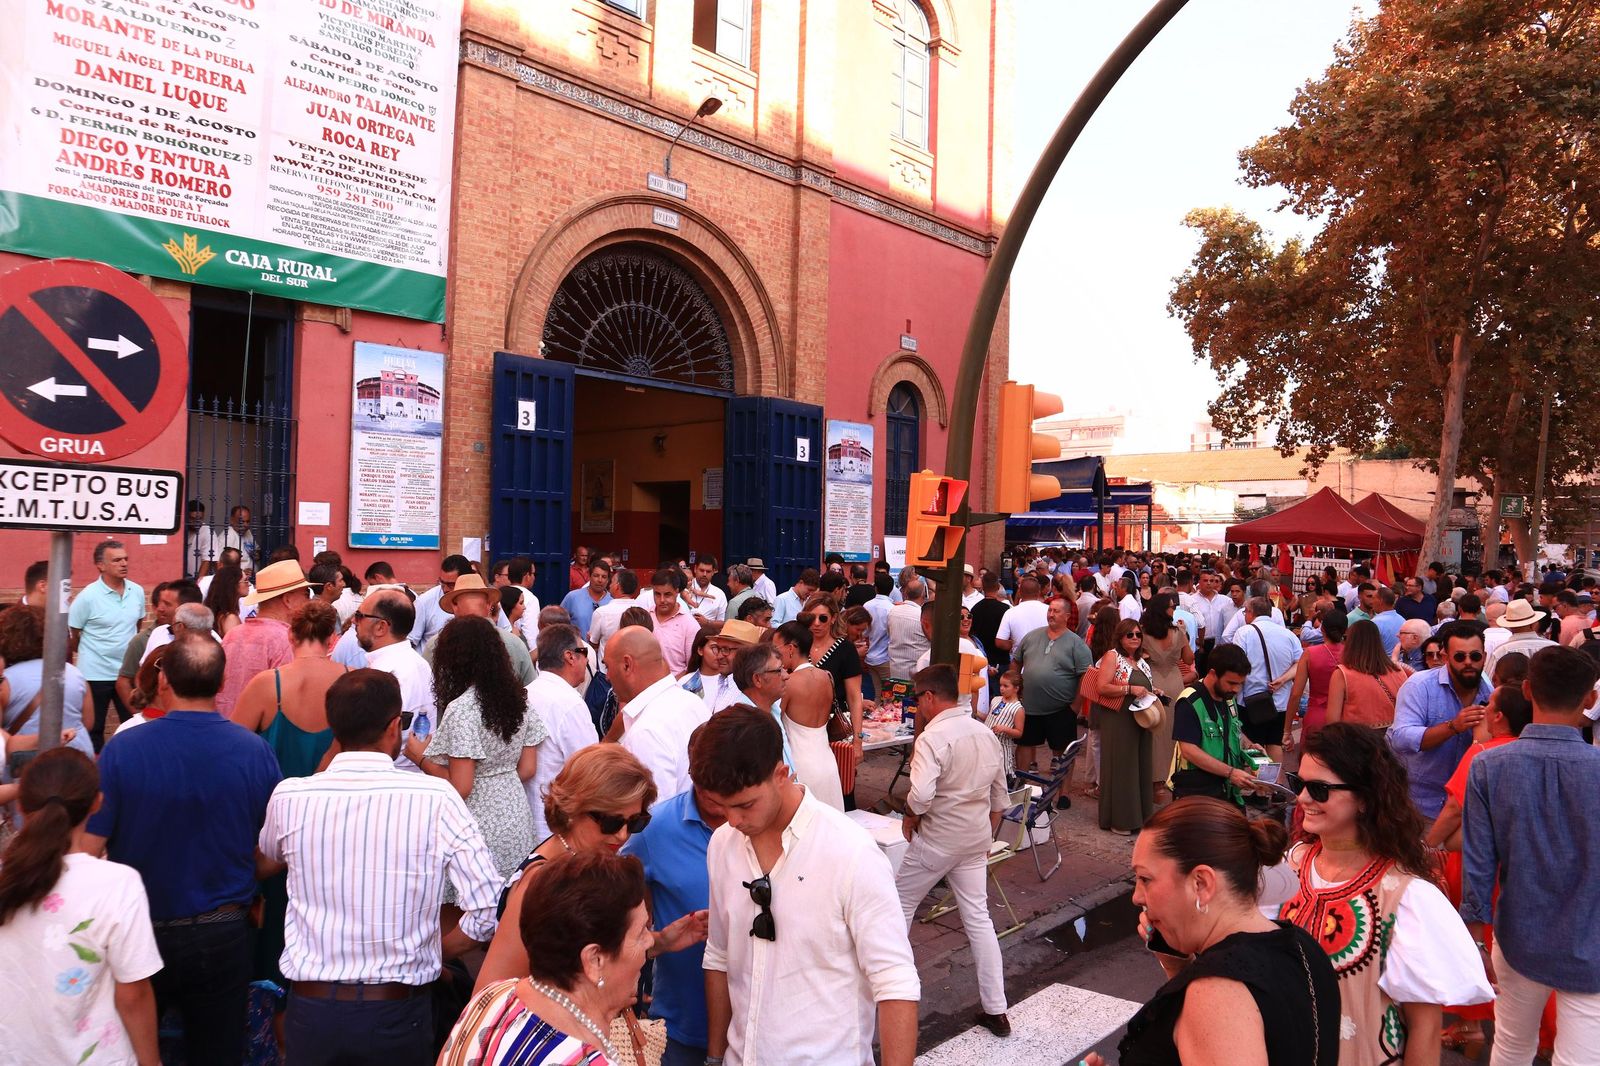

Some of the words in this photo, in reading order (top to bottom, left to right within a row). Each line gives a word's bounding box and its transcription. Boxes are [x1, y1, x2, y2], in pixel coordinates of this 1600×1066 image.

[102, 0, 221, 44] ZALDUENDO
[180, 10, 227, 32] Toros
[189, 2, 259, 30] AGOSTO
[318, 11, 376, 39] VICTORINO
[341, 0, 361, 20] DE
[367, 9, 435, 48] MIRANDA
[46, 0, 155, 45] MORANTE
[161, 37, 180, 52] DE
[184, 44, 200, 58] LA
[205, 50, 254, 74] PUEBLA
[319, 27, 372, 53] SANTIAGO
[374, 47, 414, 70] DOMECQ
[351, 30, 372, 46] LUIS
[374, 39, 413, 61] PEREDA
[53, 31, 112, 58] MIGUEL
[116, 46, 164, 72] ÁNGEL
[171, 59, 246, 94] PERERA
[310, 52, 360, 76] Corrida
[365, 71, 379, 82] de
[383, 77, 415, 95] Toros
[365, 60, 383, 73] DE
[387, 68, 438, 93] AGOSTO
[74, 58, 156, 94] DANIEL
[162, 81, 227, 116] LUQUE
[284, 74, 350, 105] ALEJANDRO
[354, 93, 434, 132] TALAVANTE
[290, 59, 296, 67] 6
[300, 62, 334, 80] JUAN
[338, 74, 376, 94] PEDRO
[380, 88, 424, 112] DOMECQ
[33, 76, 134, 110] DOMINGO
[140, 103, 148, 113] 4
[154, 106, 180, 120] DE
[185, 114, 256, 139] AGOSTO
[59, 97, 132, 123] Corrida
[138, 117, 159, 128] de
[164, 122, 228, 146] Rejones
[306, 99, 352, 127] JUAN
[356, 115, 415, 146] ORTEGA
[30, 105, 40, 114] 6
[46, 108, 63, 120] D.
[69, 112, 137, 137] FERMÍN
[142, 129, 240, 163] BOHÓRQUEZ
[60, 126, 128, 157] DIEGO
[134, 143, 230, 180] VENTURA
[322, 126, 364, 152] ROCA
[370, 140, 400, 162] REY
[56, 144, 144, 181] ANDRÉS
[150, 167, 231, 199] ROMERO
[270, 164, 308, 179] RESERVA
[273, 154, 436, 203] WWW.TOROSPEREDA.COM
[288, 139, 334, 157] VENTA
[338, 153, 386, 172] ONLINE
[389, 167, 427, 184] DESDE
[301, 152, 317, 162] EL
[320, 158, 334, 167] 27
[338, 162, 356, 172] DE
[358, 168, 396, 184] JUNIO
[400, 179, 415, 189] EN
[80, 179, 138, 199] AMADORES
[141, 192, 154, 202] DE
[158, 195, 193, 210] MOURA
[196, 203, 202, 212] Y
[110, 196, 167, 215] AMADORES
[170, 208, 182, 218] DE
[186, 211, 230, 228] TURLOCK
[316, 184, 340, 198] 959
[345, 191, 366, 204] 281
[371, 198, 393, 211] 500
[225, 250, 273, 270] CAJA
[278, 258, 337, 282] RURAL
[261, 272, 283, 284] DEL
[286, 276, 308, 288] SUR
[522, 410, 530, 426] 3
[40, 438, 106, 456] GRUA
[800, 446, 805, 458] 3
[117, 478, 169, 498] BUS
